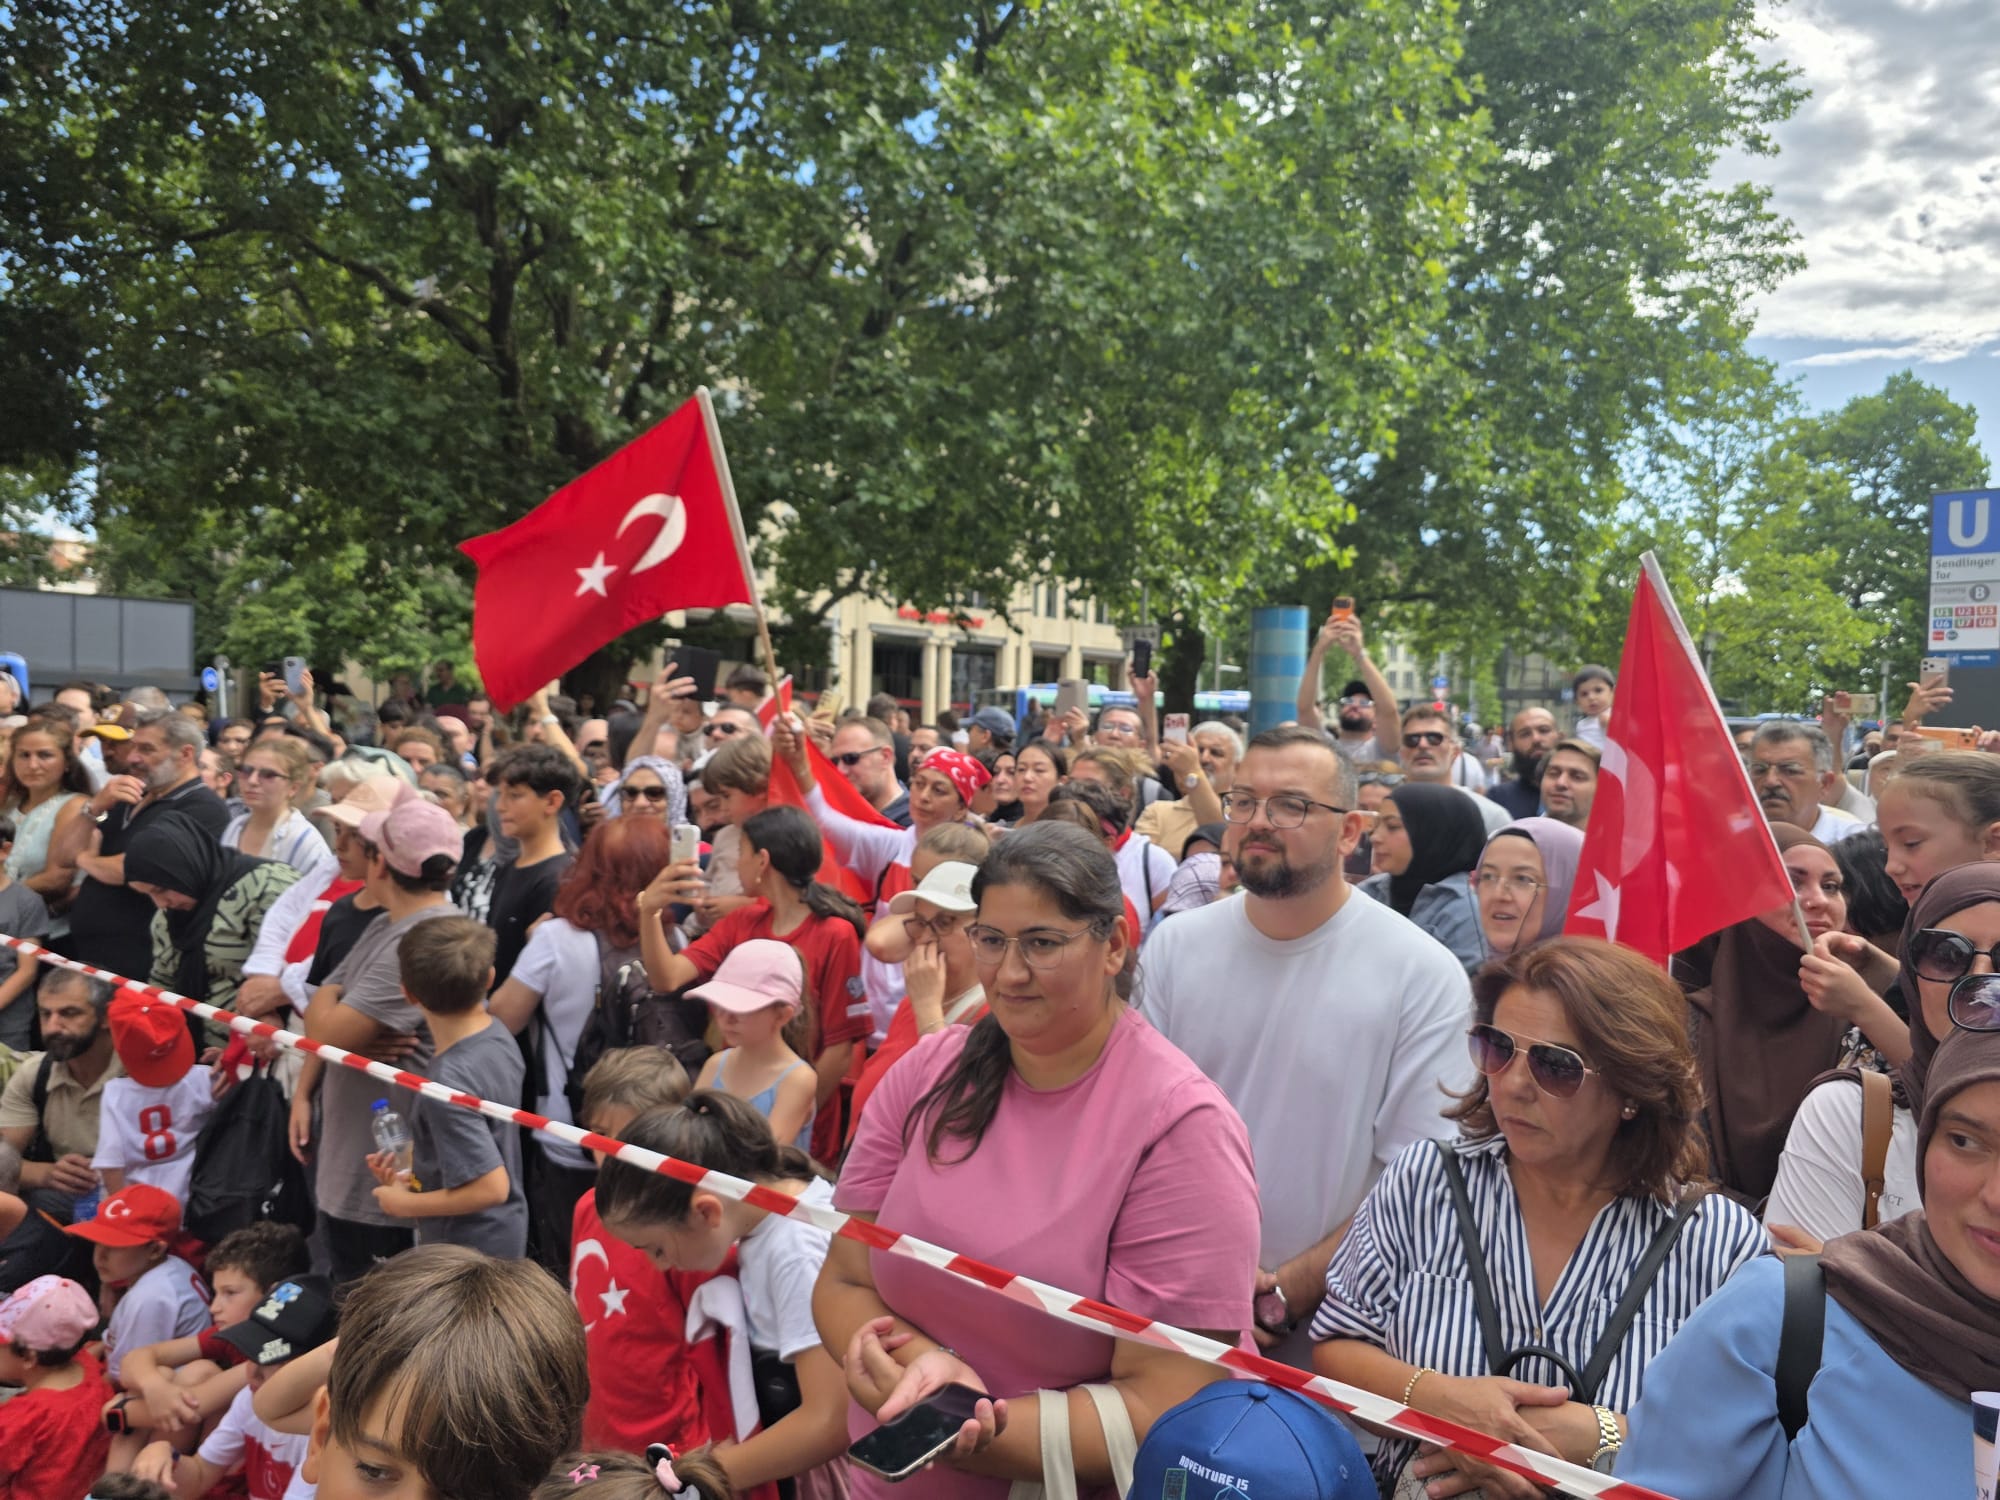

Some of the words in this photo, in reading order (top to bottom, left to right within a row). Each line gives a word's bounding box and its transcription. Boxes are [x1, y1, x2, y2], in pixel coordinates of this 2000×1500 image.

[1948, 498, 1990, 548] U
[1935, 557, 1996, 569] Sendlinger
[1975, 586, 1986, 599] B
[1935, 608, 1950, 616] U1
[1957, 607, 1972, 615] U2
[1979, 606, 1994, 614] U3
[1935, 619, 1950, 628] U6
[1957, 618, 1972, 627] U7
[139, 1104, 177, 1161] 8
[1179, 1455, 1235, 1486] ADVENTURE
[1236, 1478, 1249, 1491] IS
